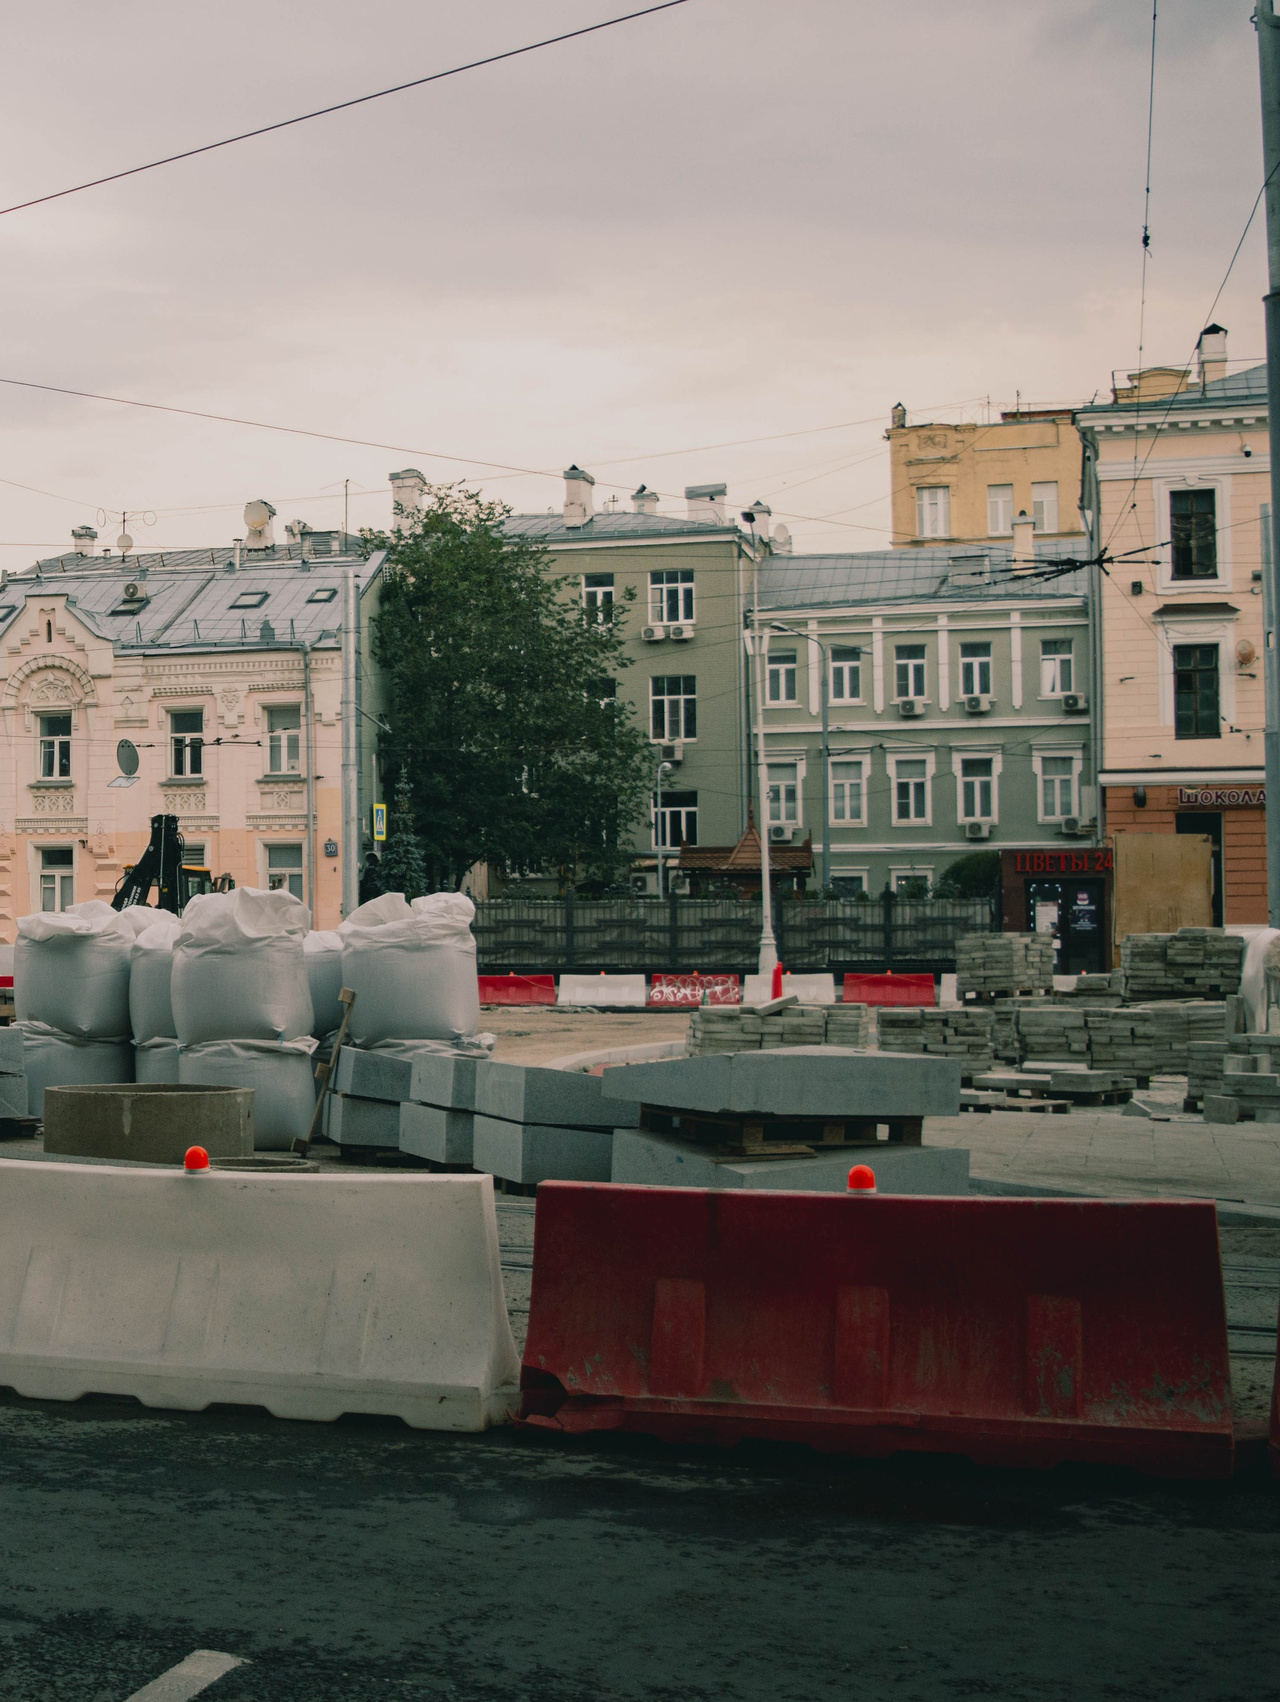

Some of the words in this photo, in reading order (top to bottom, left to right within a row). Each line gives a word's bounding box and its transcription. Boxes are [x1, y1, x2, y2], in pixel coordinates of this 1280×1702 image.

[1177, 787, 1267, 805] ШОКОЛА
[325, 844, 336, 853] 30
[1016, 852, 1089, 876] ЦВЕТЫ
[1094, 852, 1114, 871] 24
